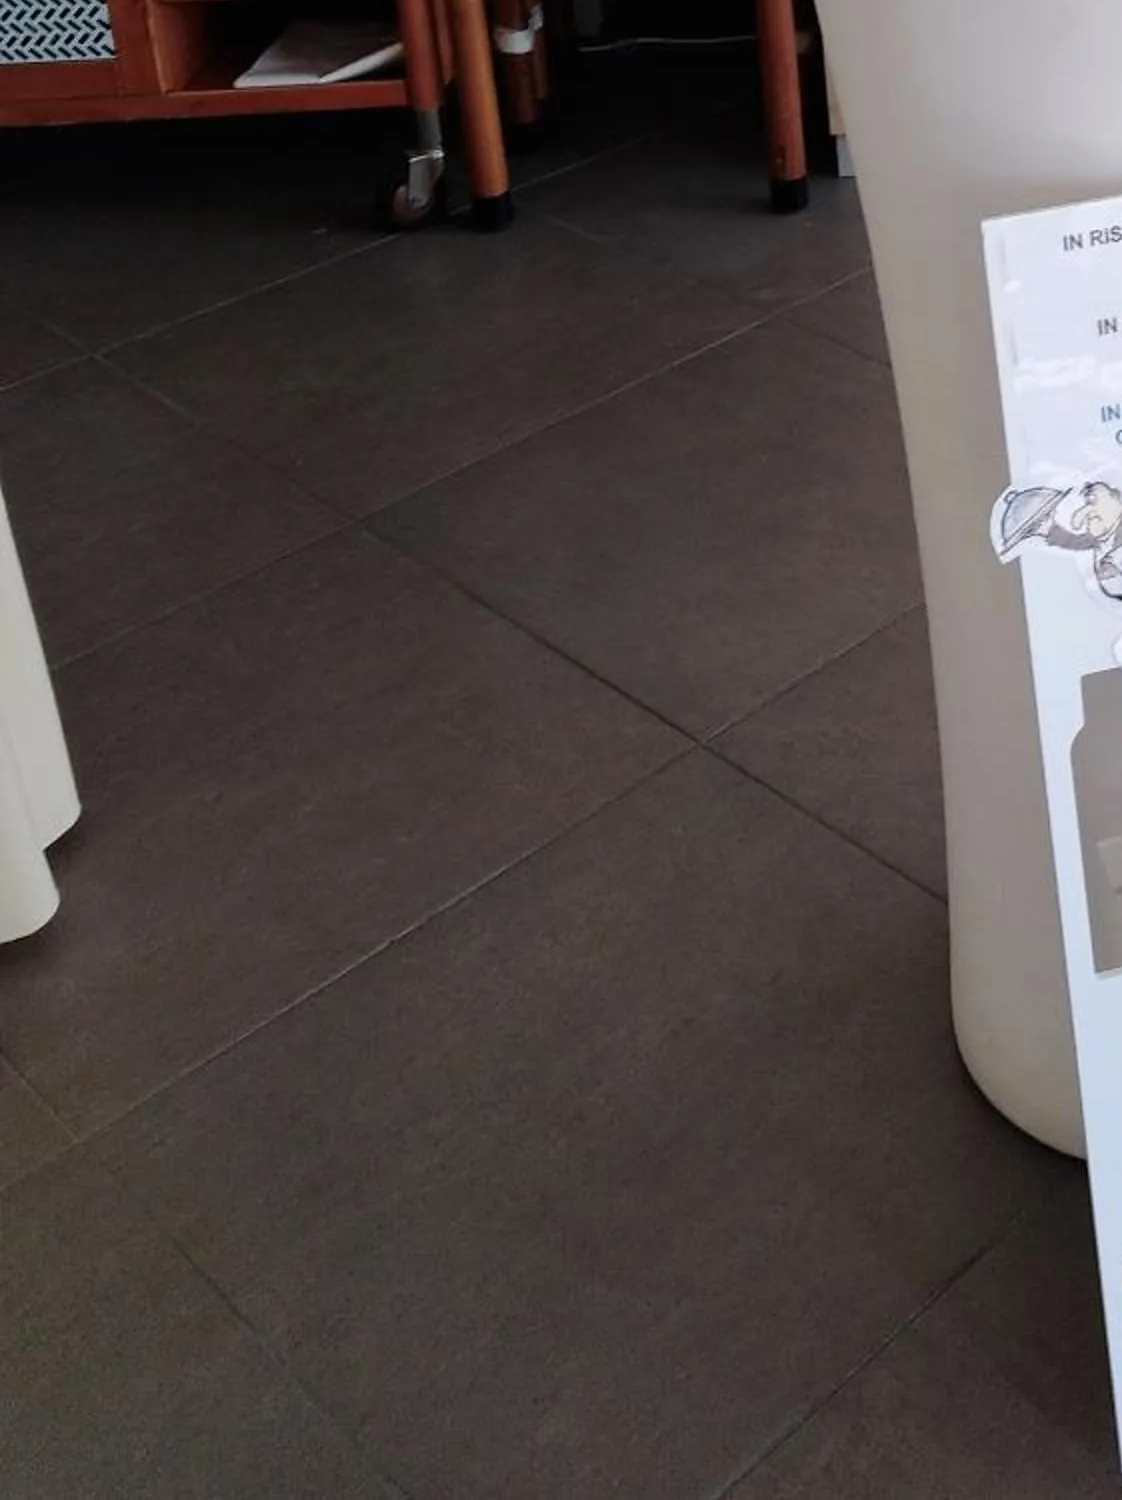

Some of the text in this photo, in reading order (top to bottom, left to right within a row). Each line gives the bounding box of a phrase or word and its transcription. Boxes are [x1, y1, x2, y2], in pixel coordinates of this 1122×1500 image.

[1063, 233, 1083, 252] IN
[1097, 317, 1117, 336] IN
[1100, 404, 1121, 424] IN
